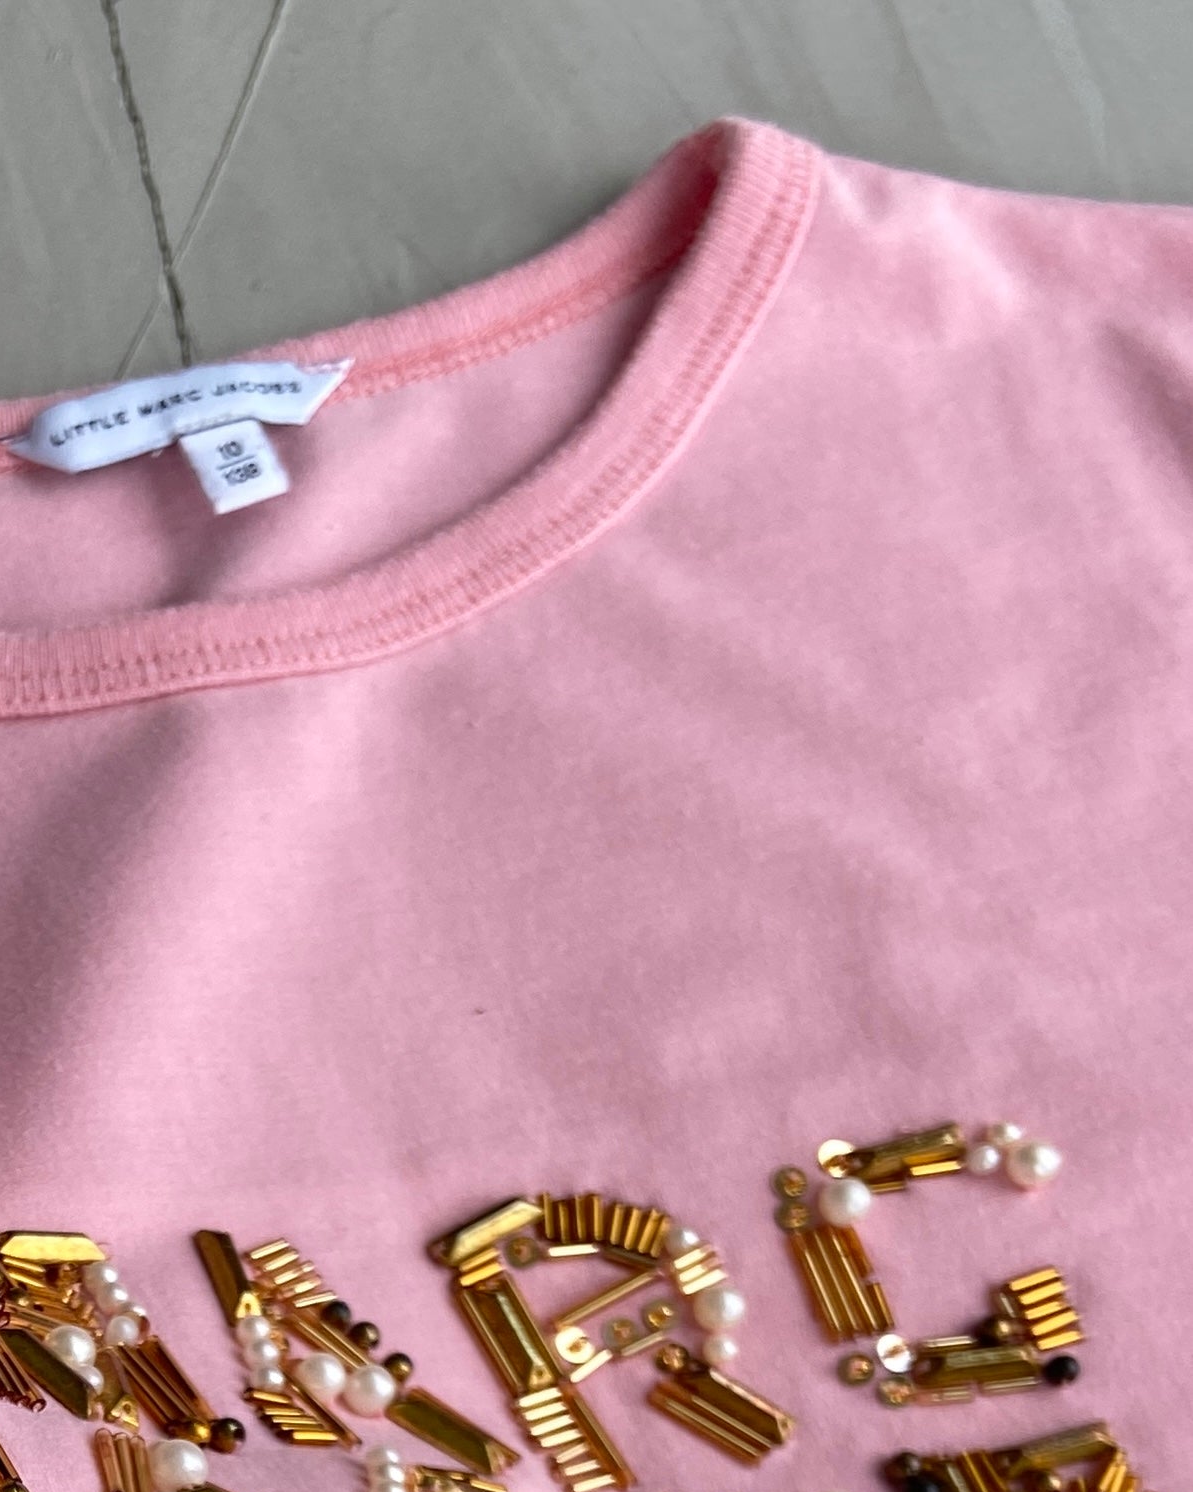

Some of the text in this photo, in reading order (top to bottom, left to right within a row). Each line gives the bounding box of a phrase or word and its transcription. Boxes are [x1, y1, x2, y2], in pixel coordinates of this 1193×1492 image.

[48, 409, 129, 448] LITTLE
[137, 388, 203, 417] MARC
[217, 440, 244, 460] 10
